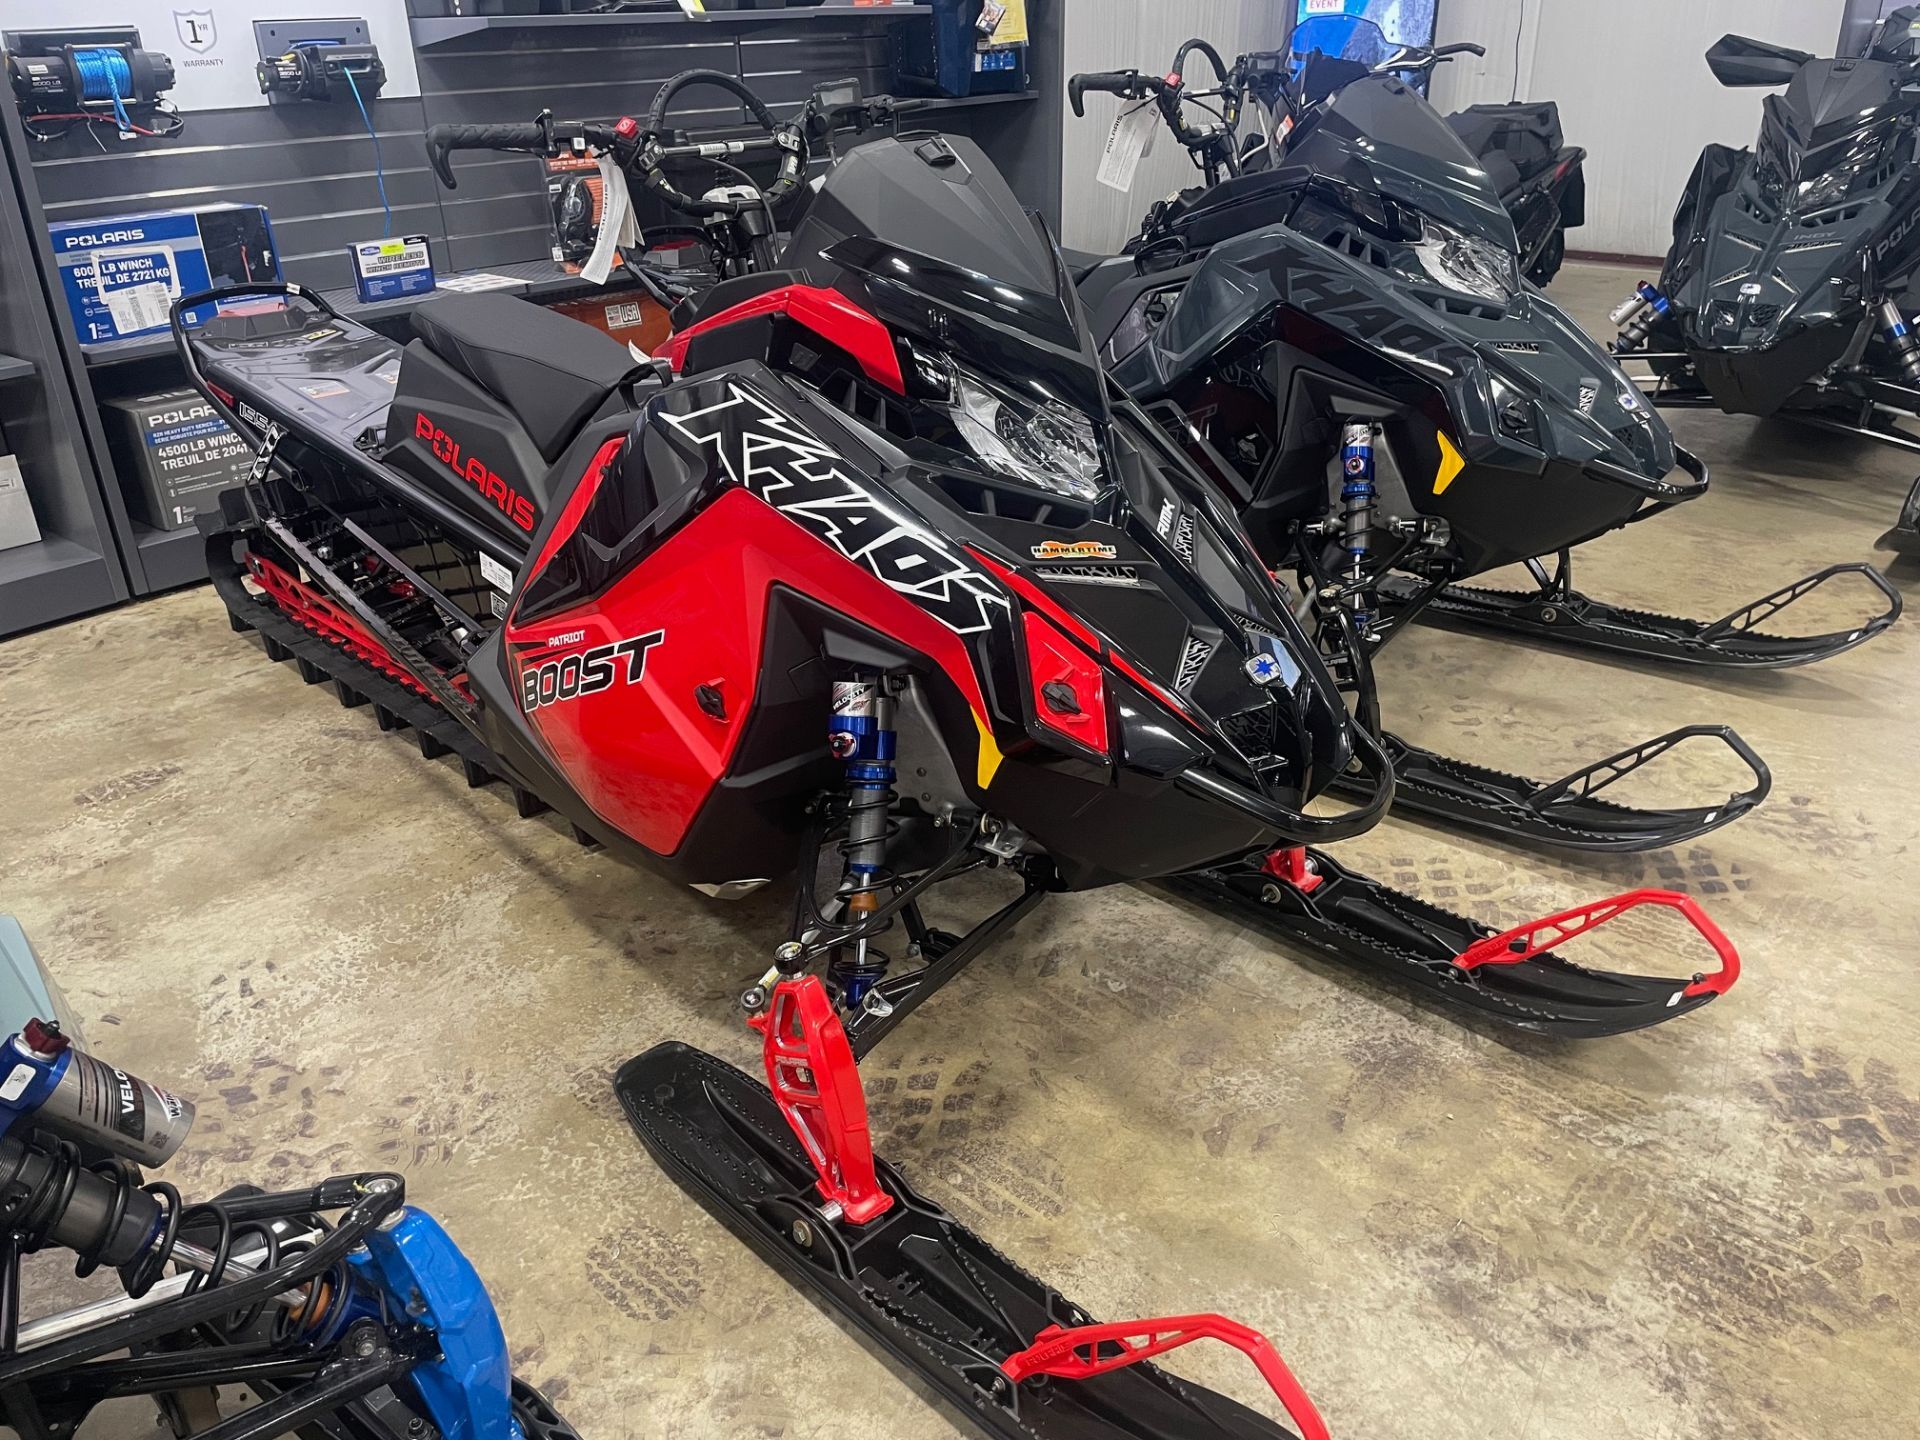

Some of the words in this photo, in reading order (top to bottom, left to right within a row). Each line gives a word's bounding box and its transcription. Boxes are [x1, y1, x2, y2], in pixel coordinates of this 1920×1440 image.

[1310, 0, 1337, 9] EVENT
[186, 20, 203, 43] 1
[183, 58, 224, 68] WARRANTY
[1105, 115, 1123, 153] POLARIS
[65, 229, 145, 248] POLARIS
[1793, 231, 1836, 241] INDY
[1876, 206, 1920, 261] POLA
[73, 266, 95, 278] 600
[102, 261, 116, 273] LB
[117, 258, 153, 270] WINCH
[116, 272, 131, 284] DE
[132, 269, 155, 281] 2721
[155, 267, 170, 278] KG
[621, 304, 639, 321] USA
[88, 323, 98, 339] 1
[148, 405, 218, 428] POLAR
[158, 443, 189, 458] 4500
[189, 439, 206, 452] LB
[207, 432, 243, 447] WINC
[160, 453, 204, 471] TREUIL
[205, 449, 221, 461] DE
[221, 443, 248, 458] 2041
[415, 412, 535, 531] POLARIS
[657, 382, 1011, 634] KHAOS
[1156, 498, 1175, 540] RMK
[1032, 546, 1114, 554] HAMMERTIME
[548, 630, 585, 647] PATRIOT
[522, 629, 665, 714] BOOST
[114, 1069, 135, 1114] VELO
